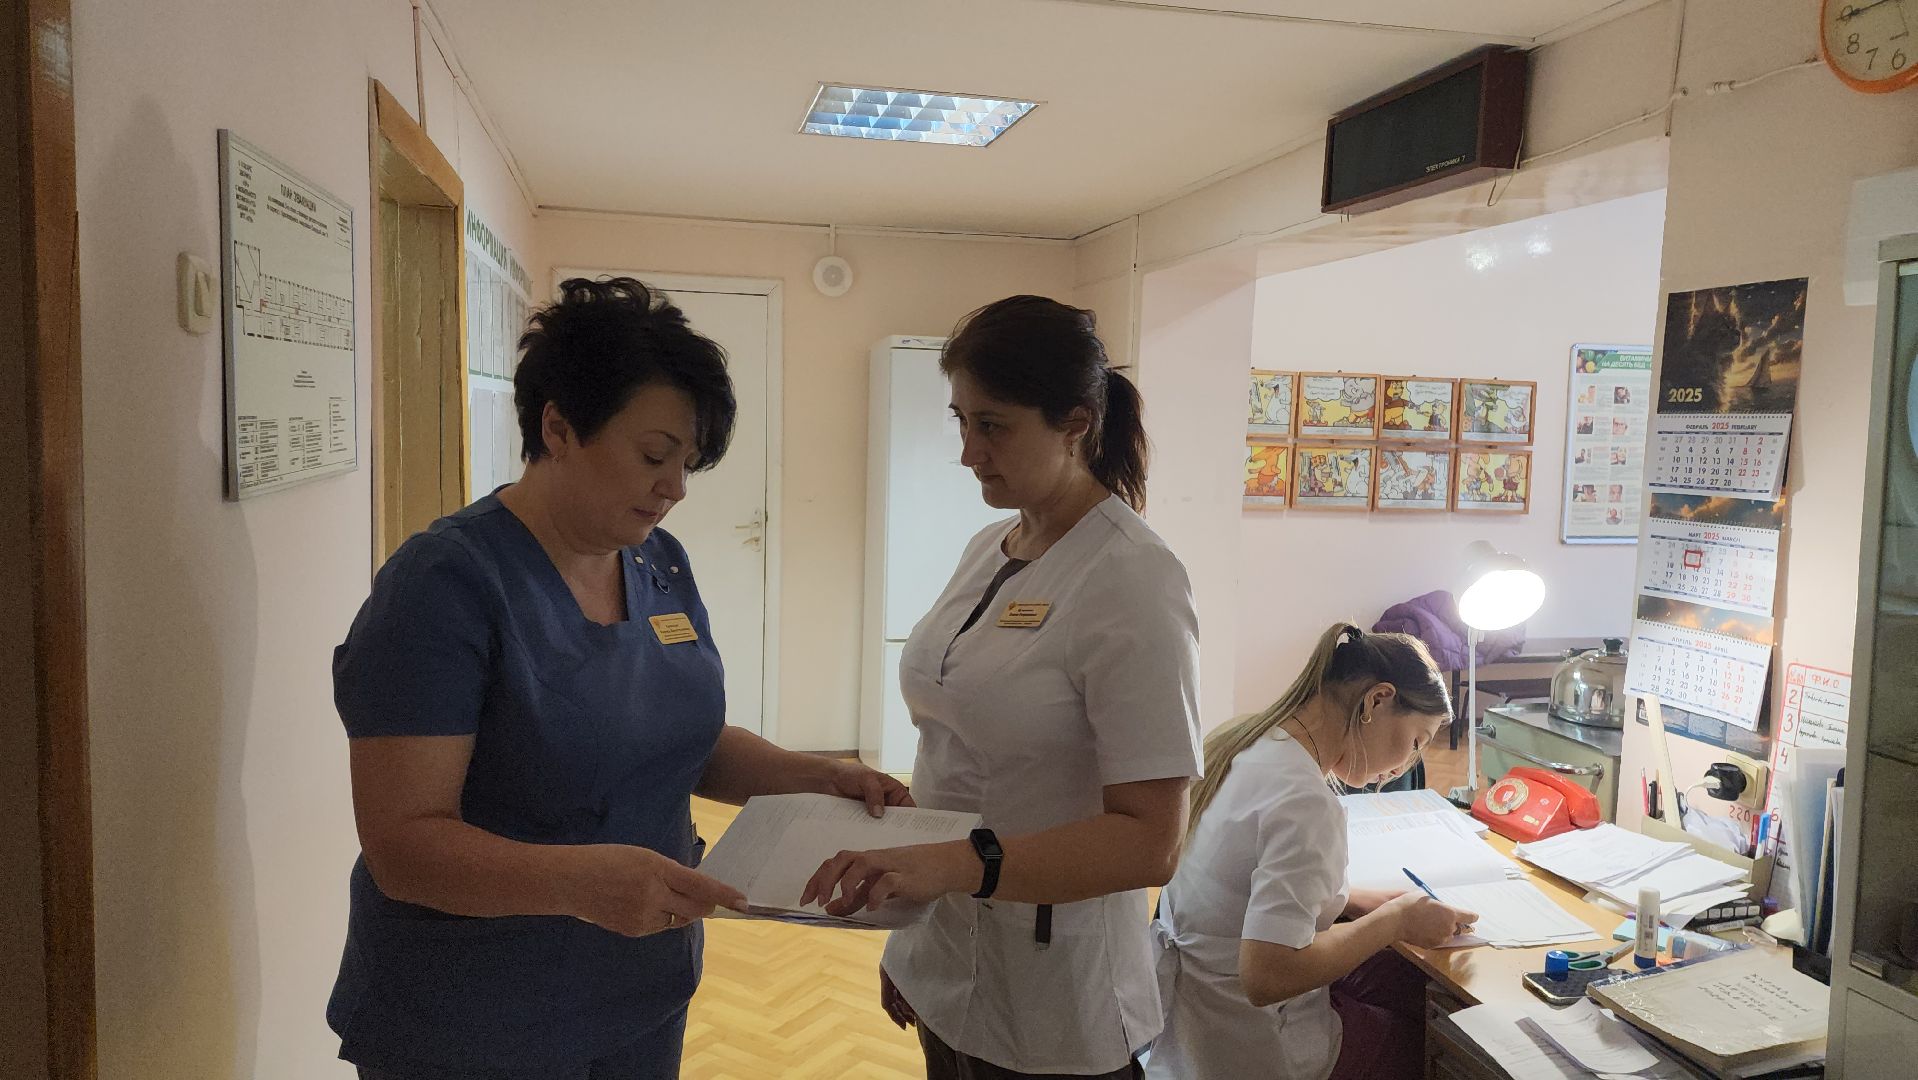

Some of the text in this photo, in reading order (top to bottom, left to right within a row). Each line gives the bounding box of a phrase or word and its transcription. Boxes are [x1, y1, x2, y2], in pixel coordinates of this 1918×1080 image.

[1847, 32, 1860, 54] 8
[1866, 47, 1878, 70] 7
[1892, 48, 1906, 70] 6
[467, 209, 507, 272] ИНФОРМАЦИЯ
[1668, 388, 1703, 402] 2025
[1704, 532, 1720, 540] 2025
[1672, 637, 1692, 645] АПРЕЛЬ
[1695, 640, 1712, 649] 2025
[1712, 668, 1717, 676] 11
[1738, 674, 1744, 682] 13
[1651, 684, 1659, 692] 28
[1680, 681, 1688, 689] 23
[1722, 692, 1730, 700] 26
[1735, 696, 1742, 704] 27
[1789, 689, 1798, 704] 2
[1784, 713, 1793, 732] 3
[1781, 748, 1788, 764] 4
[1729, 805, 1750, 822] 220
[1772, 807, 1779, 821] 6
